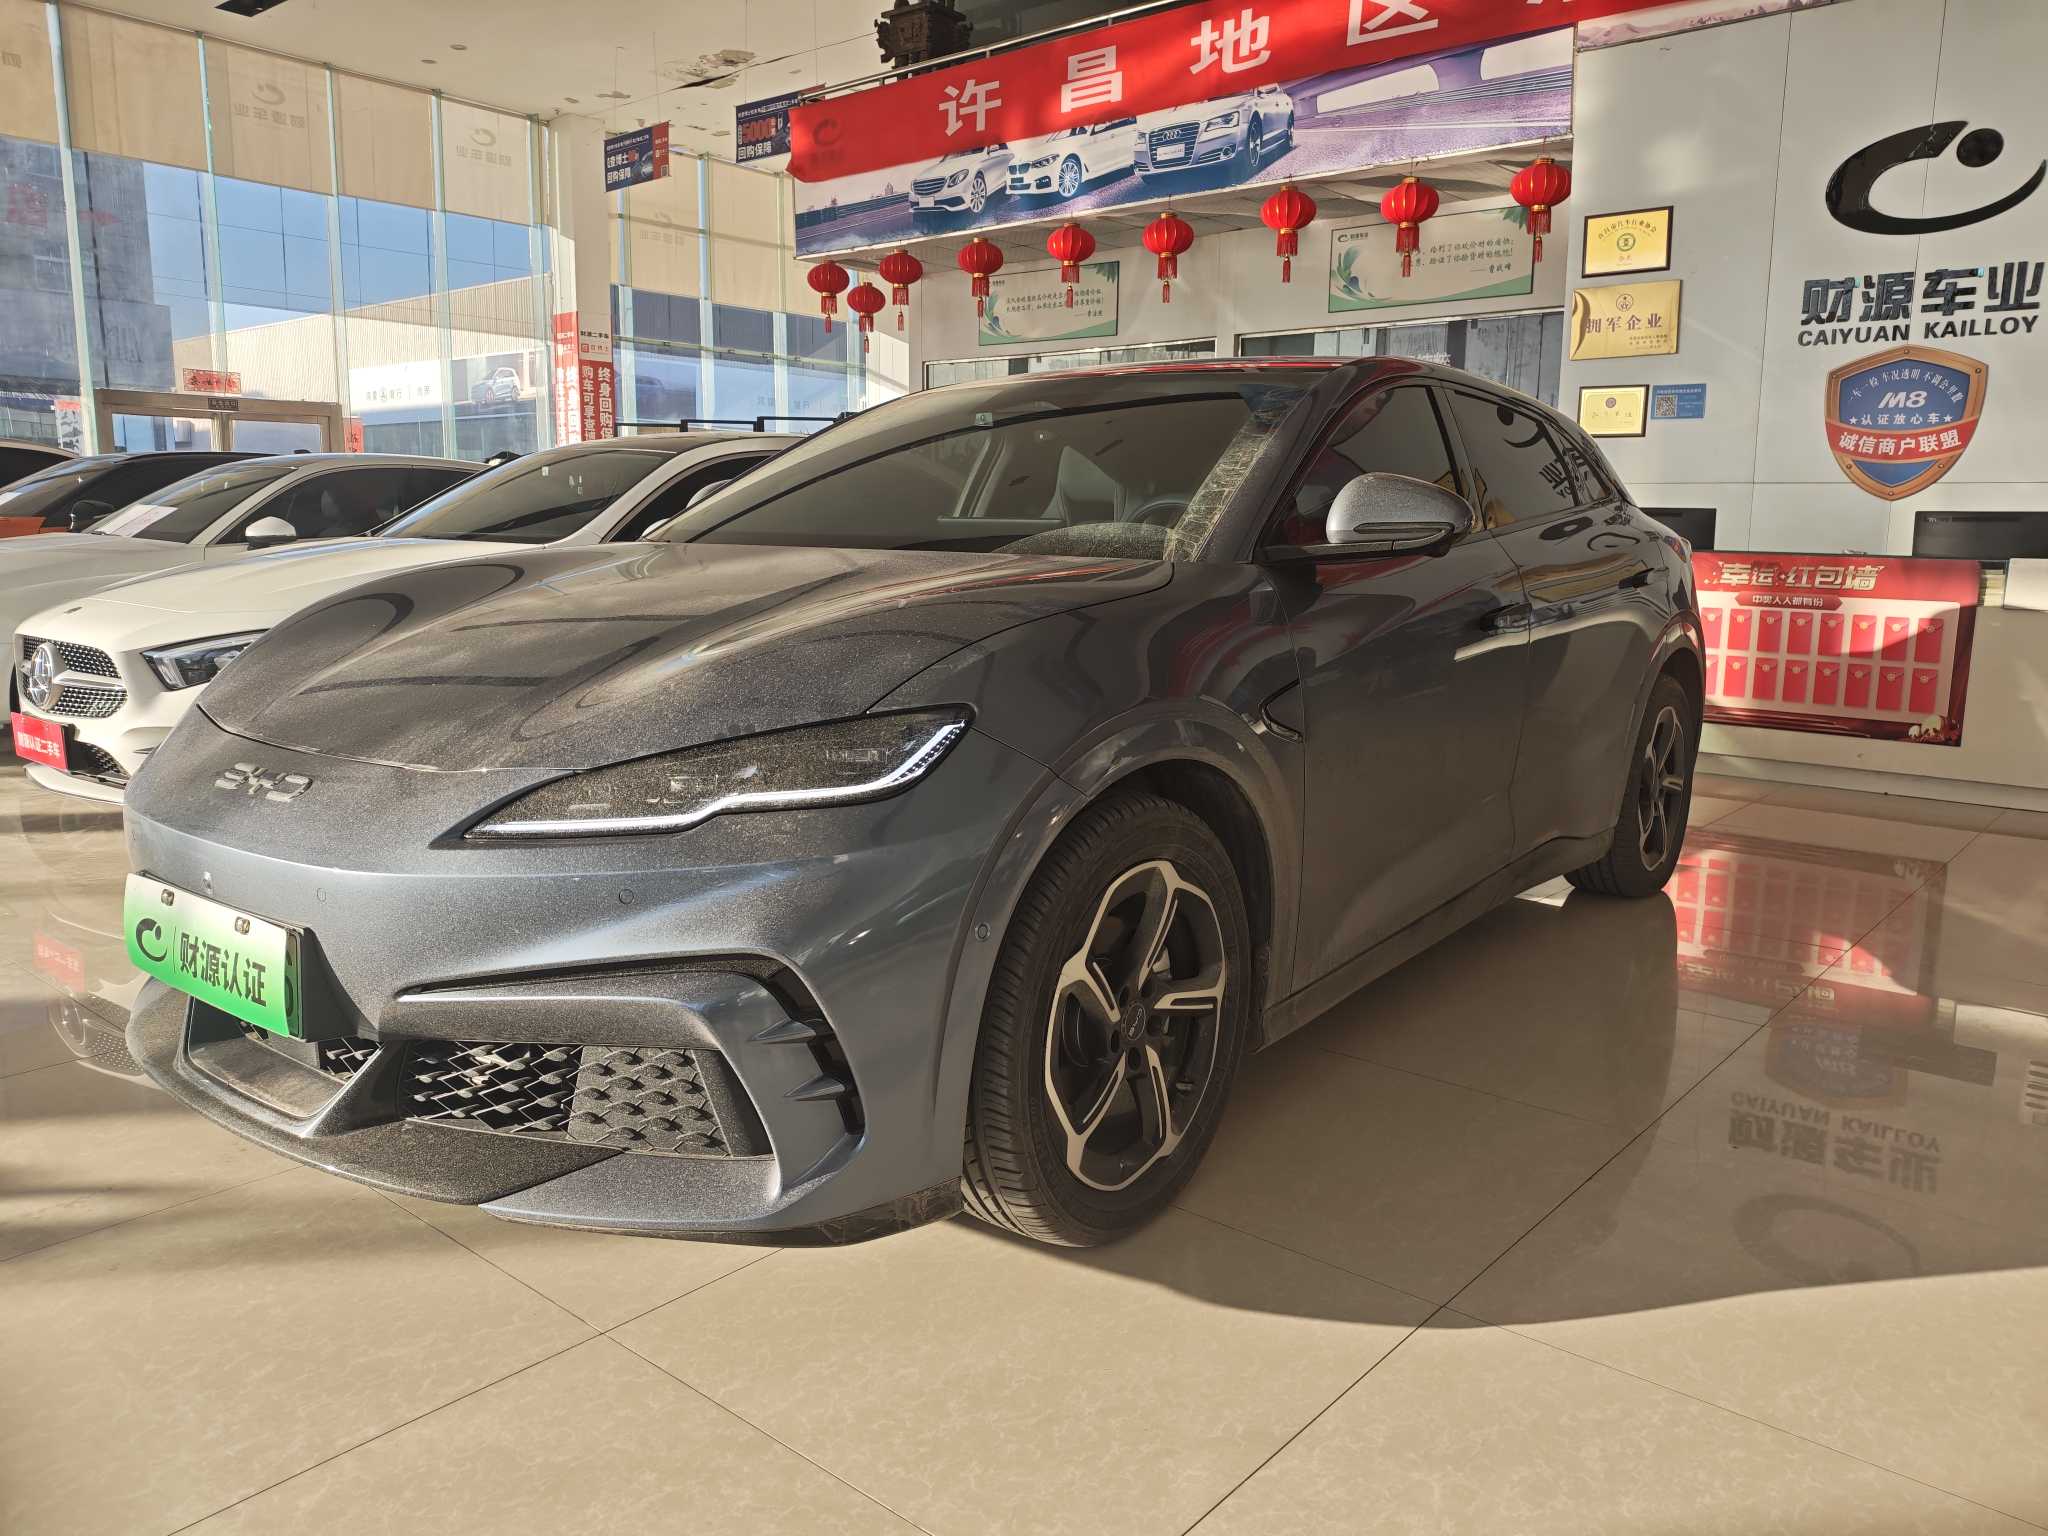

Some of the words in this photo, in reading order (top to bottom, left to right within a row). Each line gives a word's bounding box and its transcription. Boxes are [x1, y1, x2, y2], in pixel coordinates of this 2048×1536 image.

[938, 0, 1573, 138] 许昌地区
[1800, 260, 2045, 326] 财源车业
[1797, 324, 1910, 346] CAIYUAN
[1923, 315, 2039, 340] KAILLOY
[1878, 390, 1928, 409] M8
[1861, 412, 1940, 426] 认证放心车
[1838, 429, 1962, 456] 诚信商户联盟
[214, 762, 313, 802] BYD
[179, 931, 267, 1008] 财源认证
